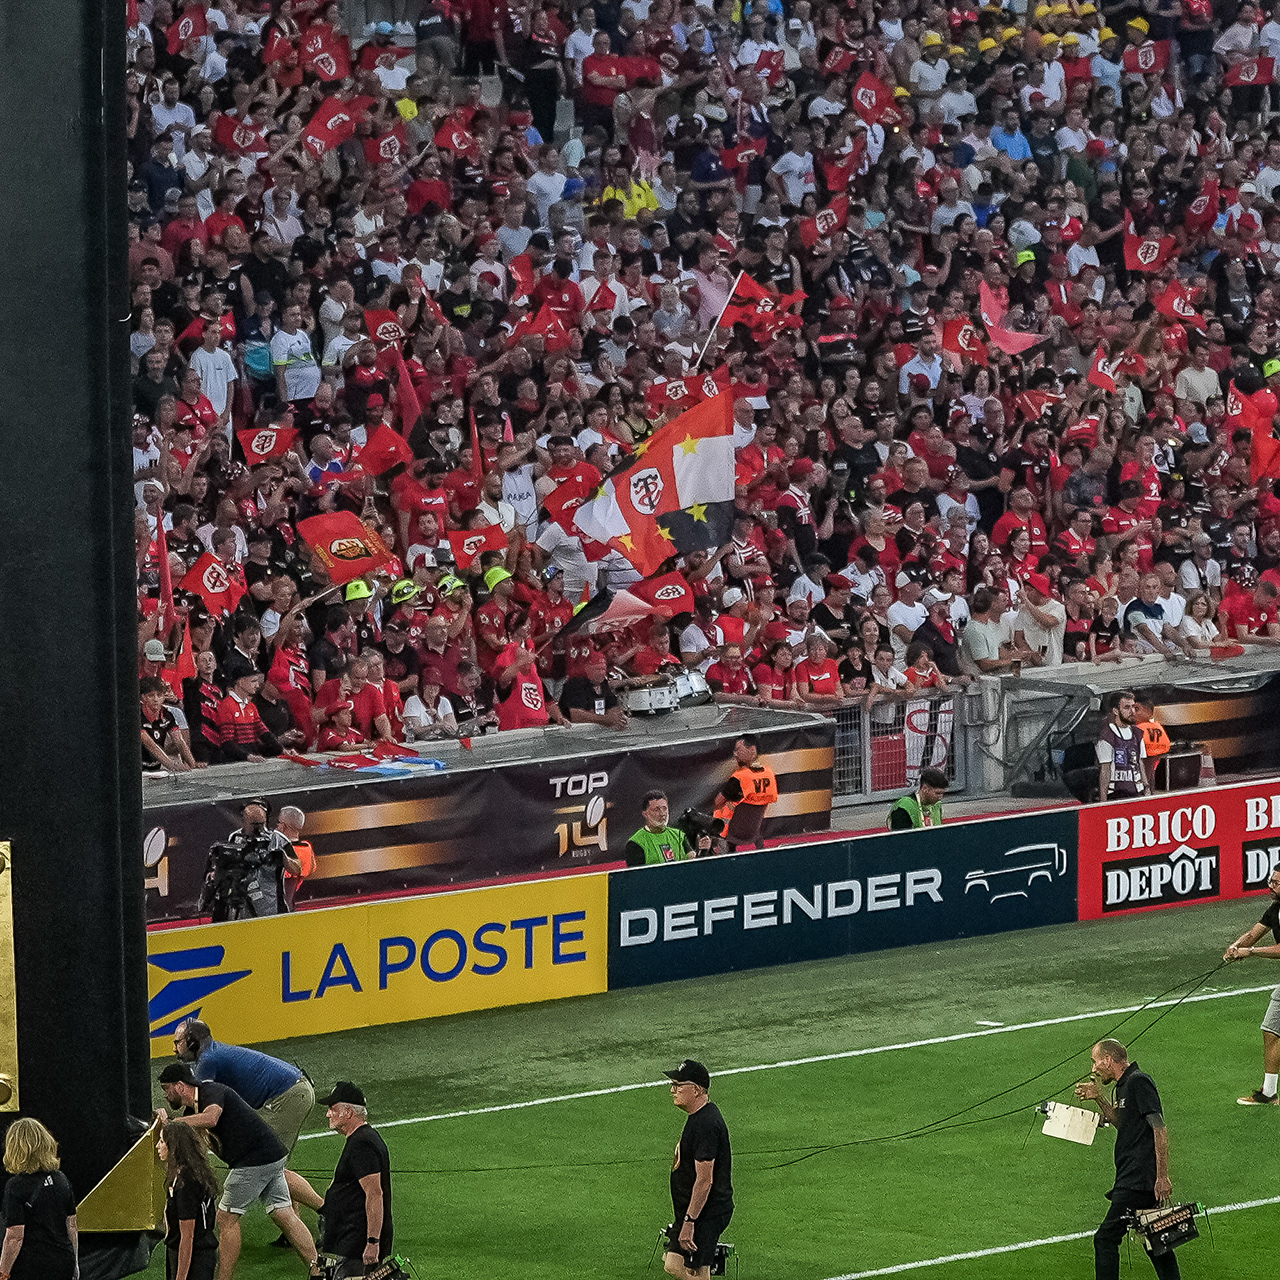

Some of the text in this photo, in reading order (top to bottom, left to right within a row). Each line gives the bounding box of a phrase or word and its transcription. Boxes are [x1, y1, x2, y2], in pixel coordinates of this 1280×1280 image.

[1147, 727, 1162, 743] VP
[549, 771, 609, 798] TOP
[753, 777, 770, 793] VP
[554, 816, 608, 857] 14
[1106, 804, 1217, 853] BRICO
[1106, 844, 1216, 906] DEPÔT
[620, 867, 944, 948] DEFENDER
[280, 909, 588, 1004] LA POSTE
